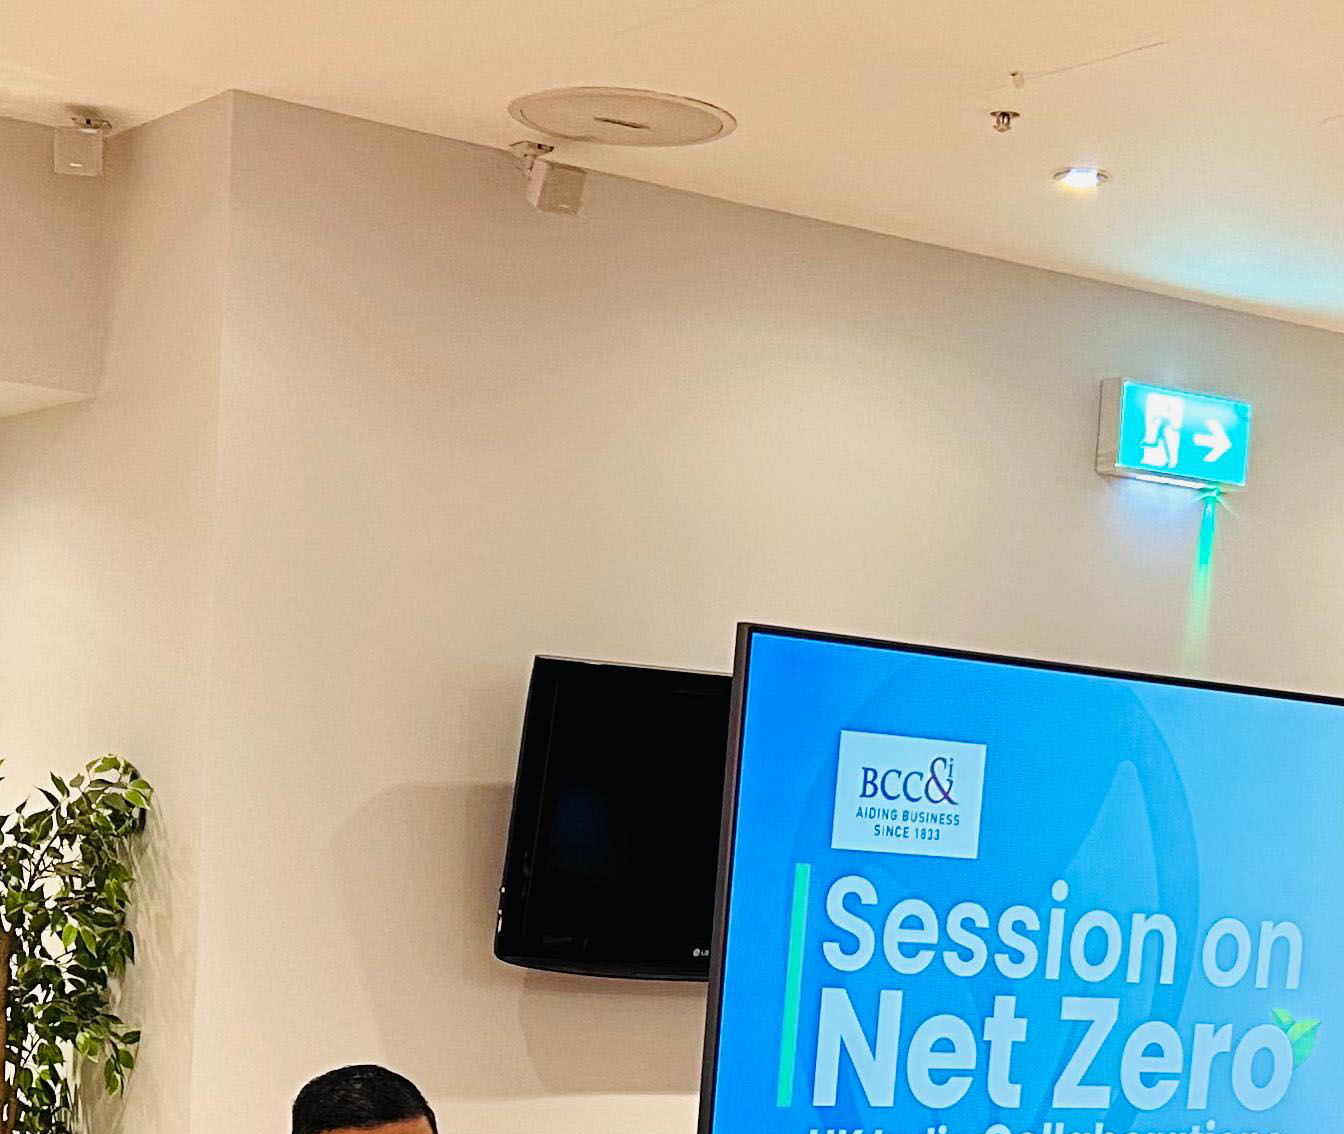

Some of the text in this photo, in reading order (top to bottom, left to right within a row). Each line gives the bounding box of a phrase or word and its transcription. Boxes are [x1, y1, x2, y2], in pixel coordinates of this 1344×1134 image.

[856, 807, 960, 826] AIDING BUSINESS
[875, 825, 941, 841] SINCE 1833
[822, 875, 1303, 990] Session on
[812, 986, 1294, 1111] Net Zero
